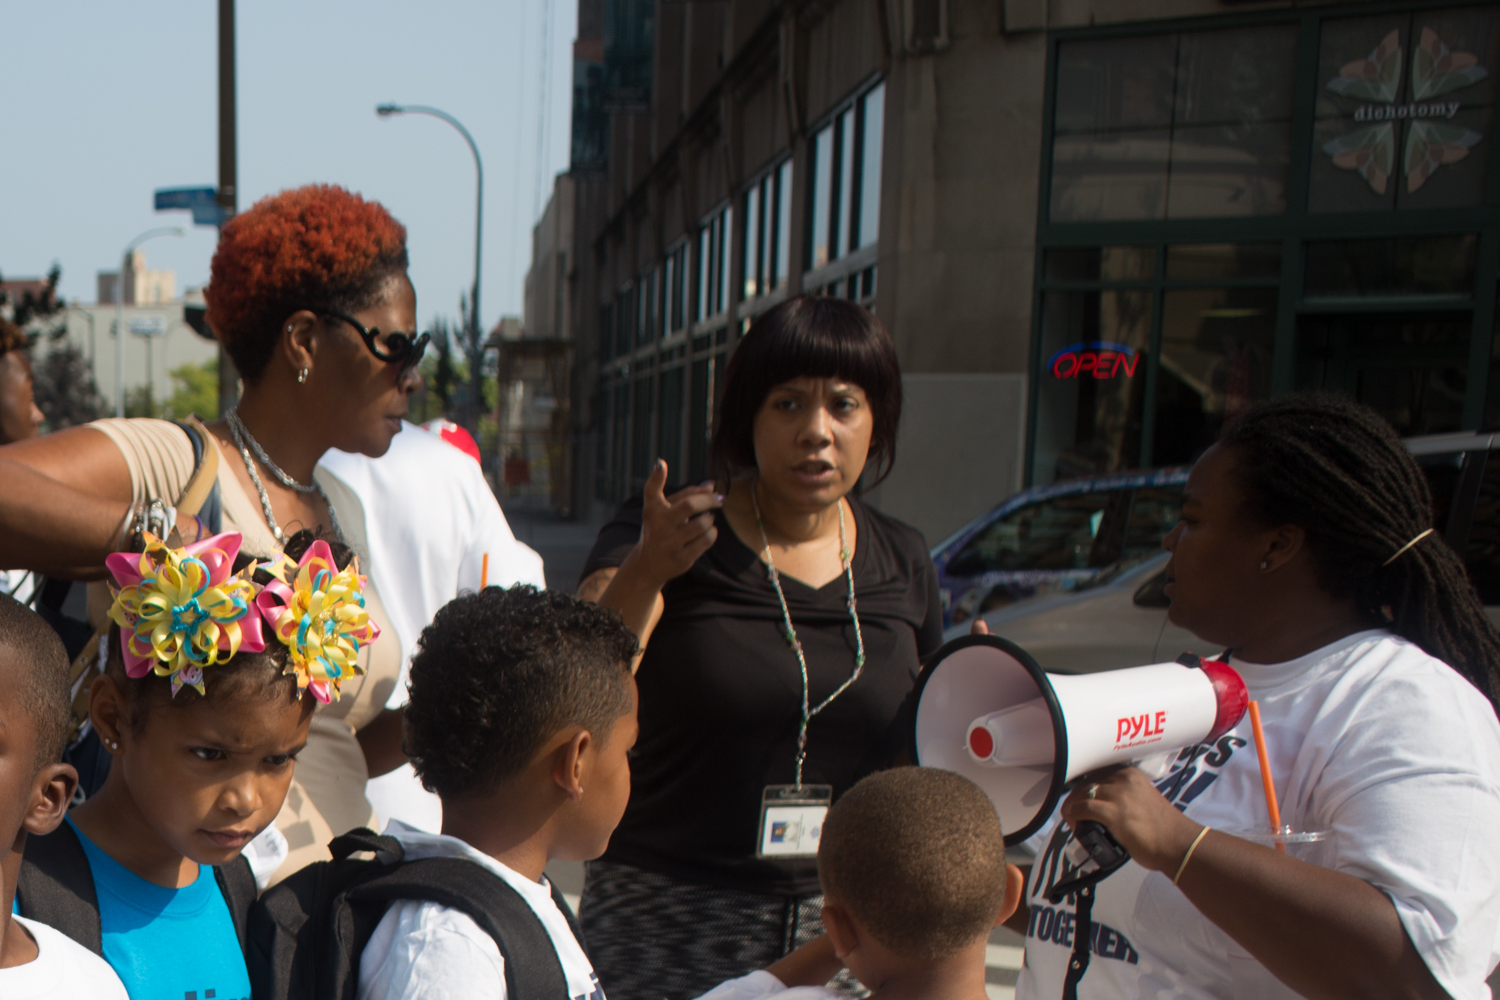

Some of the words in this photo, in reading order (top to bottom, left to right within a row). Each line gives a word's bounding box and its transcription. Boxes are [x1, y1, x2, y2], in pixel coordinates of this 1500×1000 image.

[1354, 101, 1460, 122] dichotomy
[1053, 352, 1140, 379] OPEN
[1115, 711, 1166, 743] PYLE
